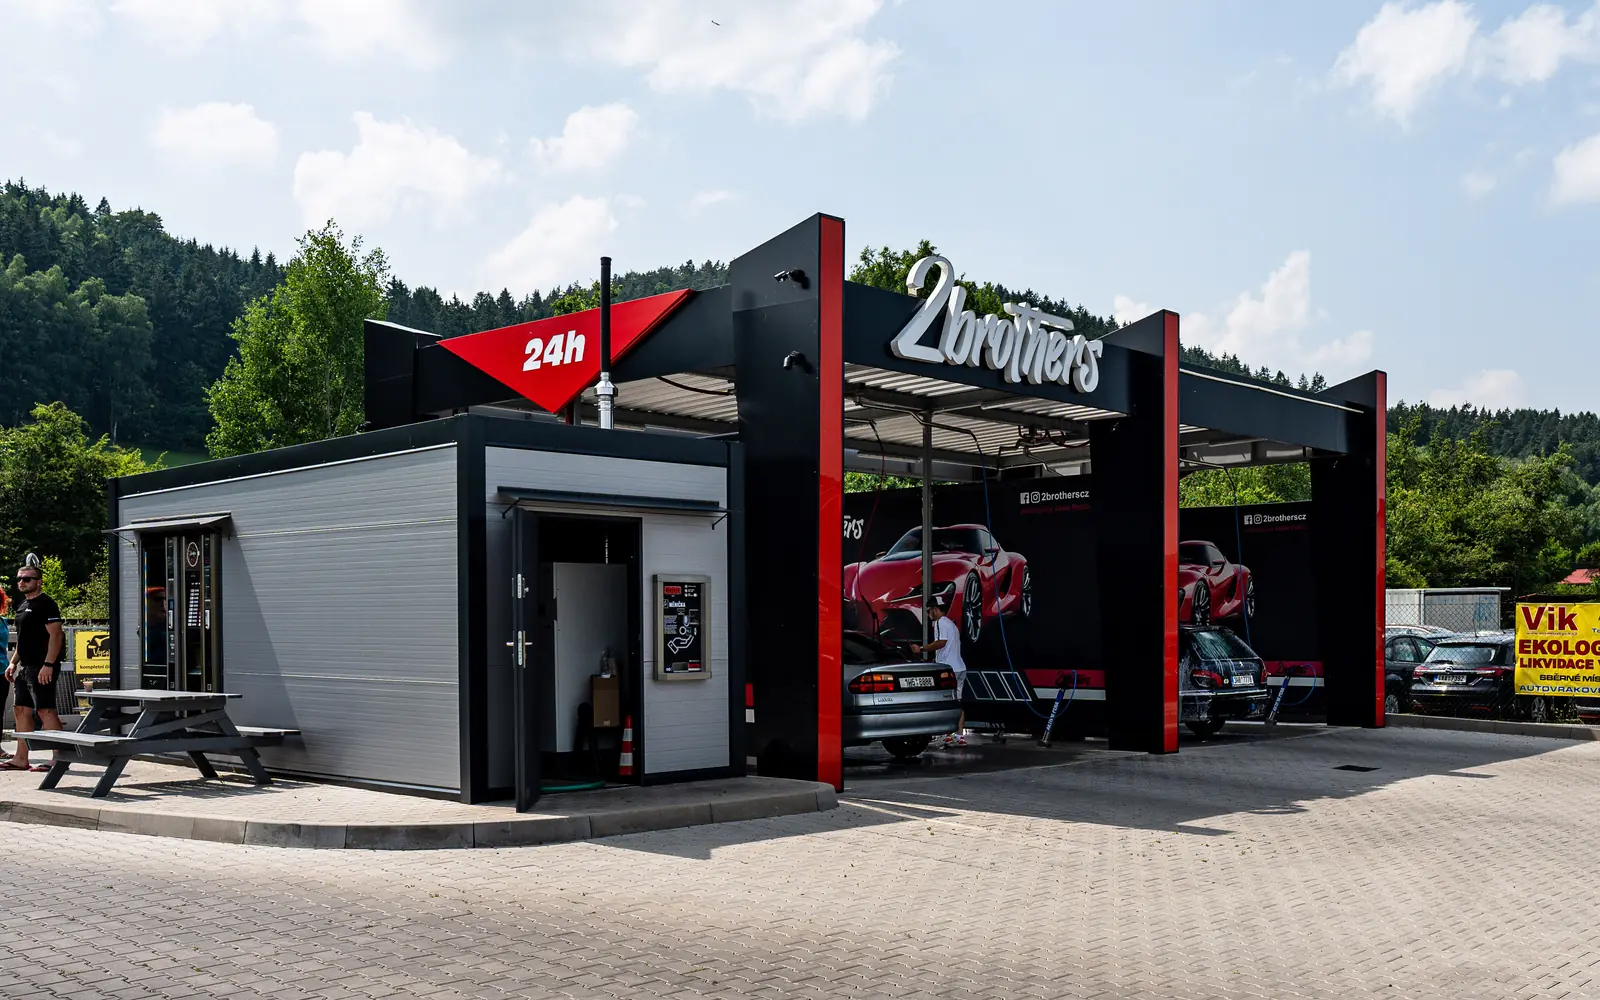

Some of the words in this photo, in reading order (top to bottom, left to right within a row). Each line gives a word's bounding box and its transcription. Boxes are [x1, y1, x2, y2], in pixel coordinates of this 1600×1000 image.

[891, 255, 1103, 393] 2brothers
[522, 330, 586, 372] 24h
[1041, 490, 1090, 502] 2brotherscz
[1263, 514, 1307, 523] 2brotherscz
[1521, 606, 1578, 631] Vik
[1520, 658, 1594, 670] LIKVIDACE
[1540, 673, 1581, 682] SBĚRNÉ
